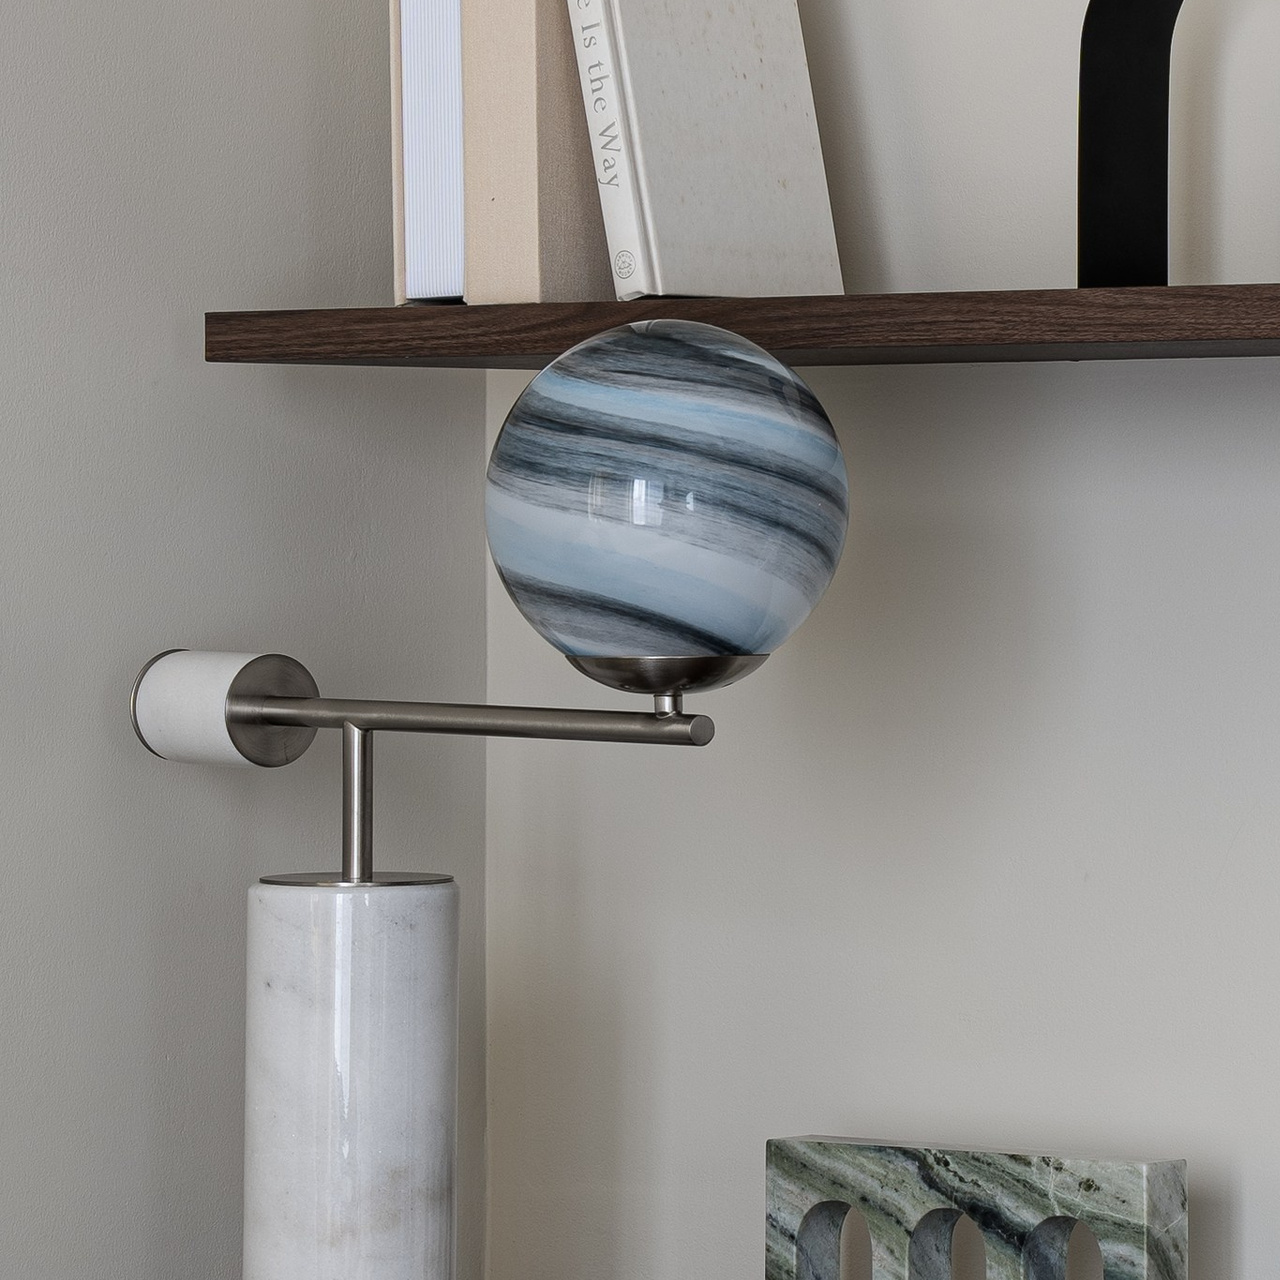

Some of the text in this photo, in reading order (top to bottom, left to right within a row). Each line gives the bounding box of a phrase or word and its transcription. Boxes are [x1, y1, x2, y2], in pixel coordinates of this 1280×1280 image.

[580, 21, 601, 49] Is
[587, 60, 612, 114] the
[598, 118, 622, 188] Way
